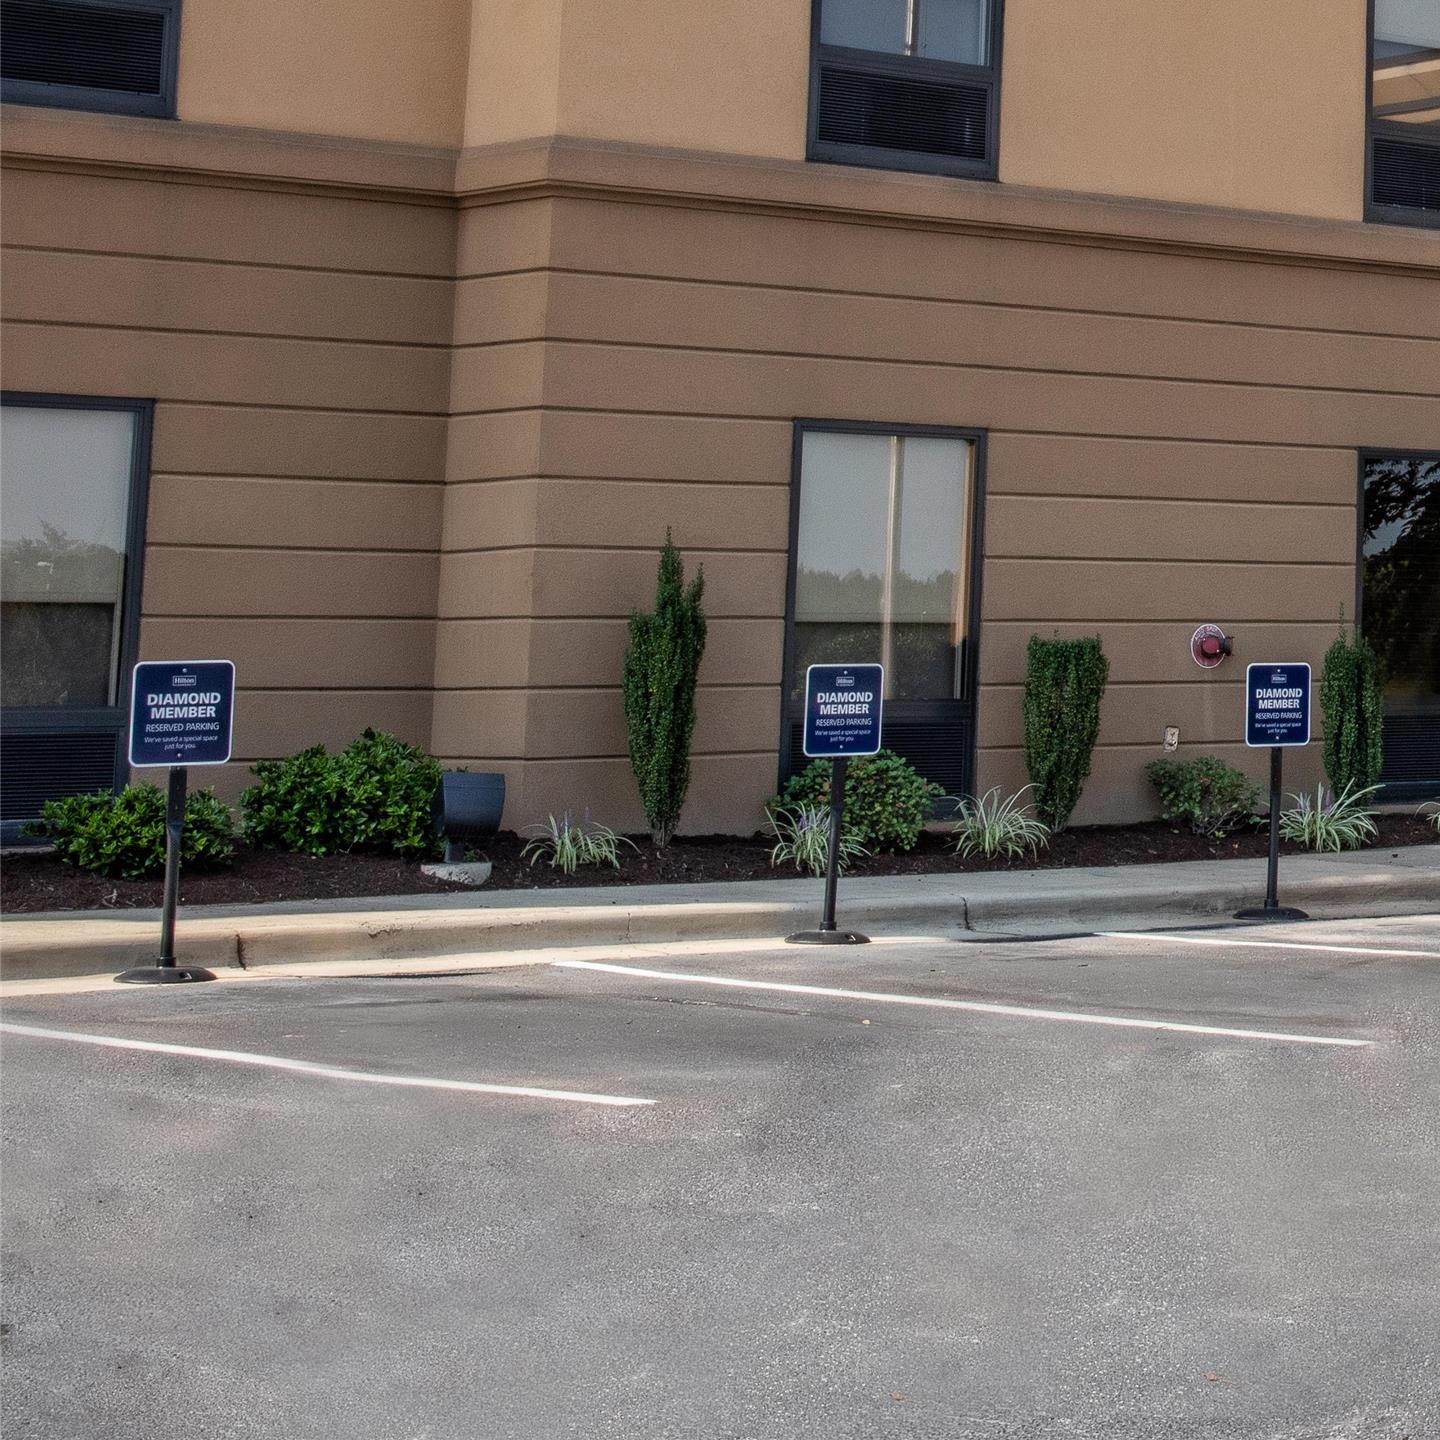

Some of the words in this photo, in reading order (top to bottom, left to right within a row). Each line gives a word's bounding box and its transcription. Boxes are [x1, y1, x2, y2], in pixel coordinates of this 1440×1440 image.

[174, 677, 195, 685] Hilton
[147, 692, 221, 706] DIAMOND
[817, 692, 873, 703] DIAMOND
[1256, 688, 1303, 699] DIAMOND
[820, 704, 869, 715] MEMBER
[1259, 699, 1300, 709] MEMBER
[151, 706, 216, 719] MEMBER
[146, 723, 184, 733] RESERVED
[186, 722, 220, 731] PARKING
